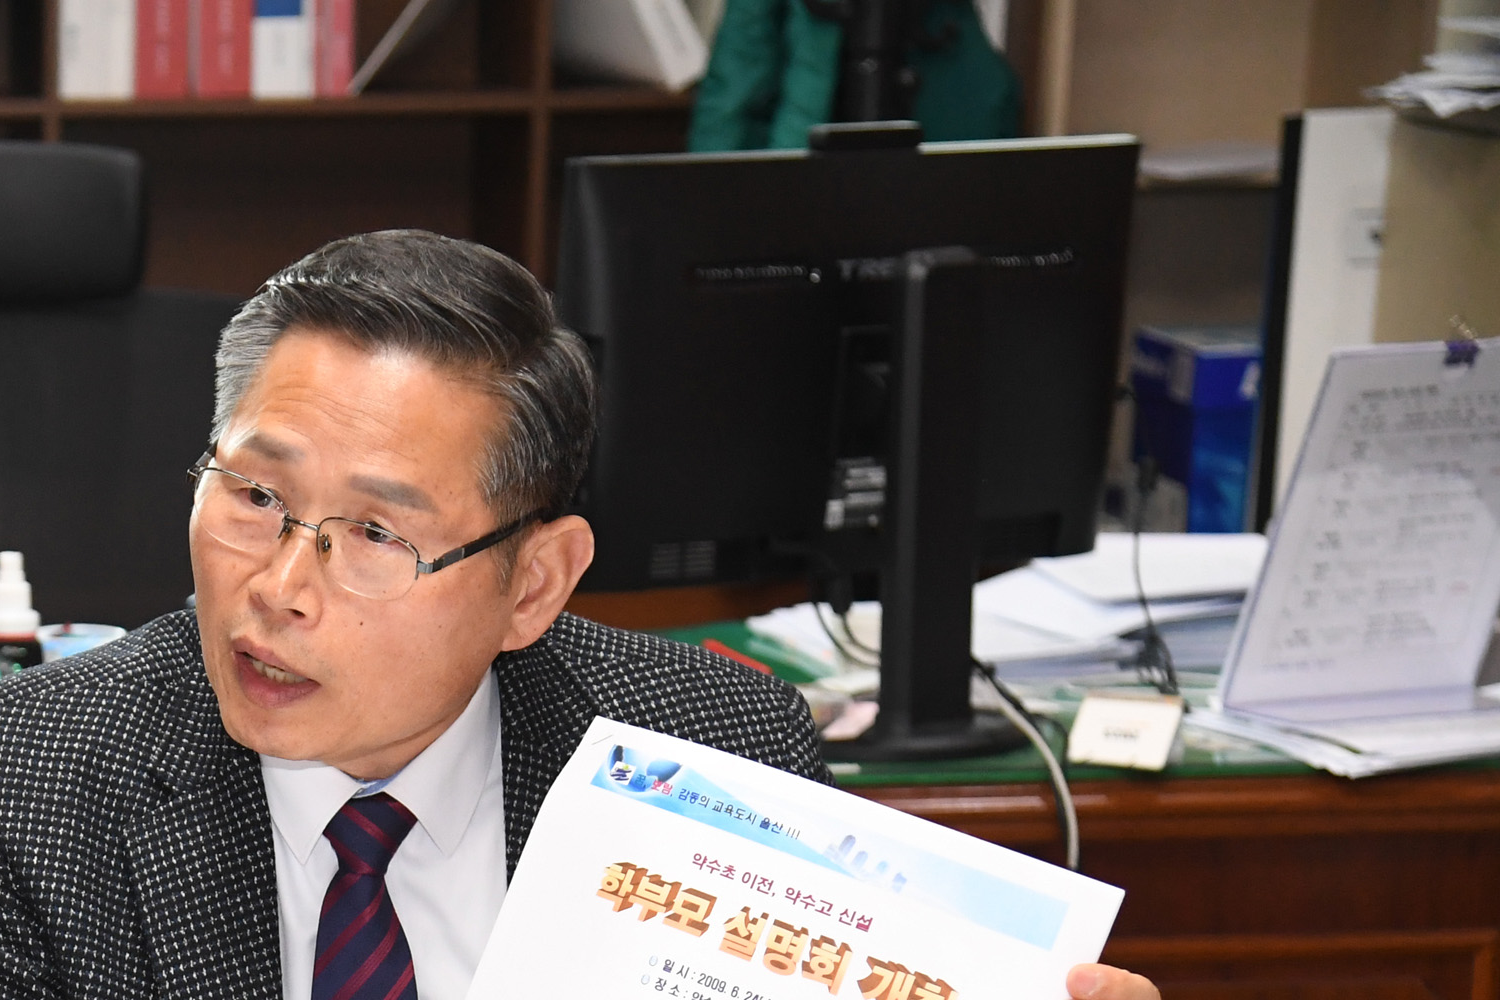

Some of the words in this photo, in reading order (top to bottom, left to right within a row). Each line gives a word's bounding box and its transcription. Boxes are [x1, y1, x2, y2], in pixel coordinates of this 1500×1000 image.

[651, 779, 673, 797] 보람,
[678, 788, 711, 808] 감동의
[711, 800, 757, 825] 교육도시
[759, 817, 784, 835] 울산
[692, 852, 736, 880] 약수초
[741, 871, 776, 898] 이전,
[784, 886, 834, 917] 약수고
[839, 907, 874, 933] 신설
[596, 861, 718, 937] 학부모
[719, 905, 854, 996] 설명회
[697, 972, 727, 994] 2009.
[730, 986, 740, 999] 6.
